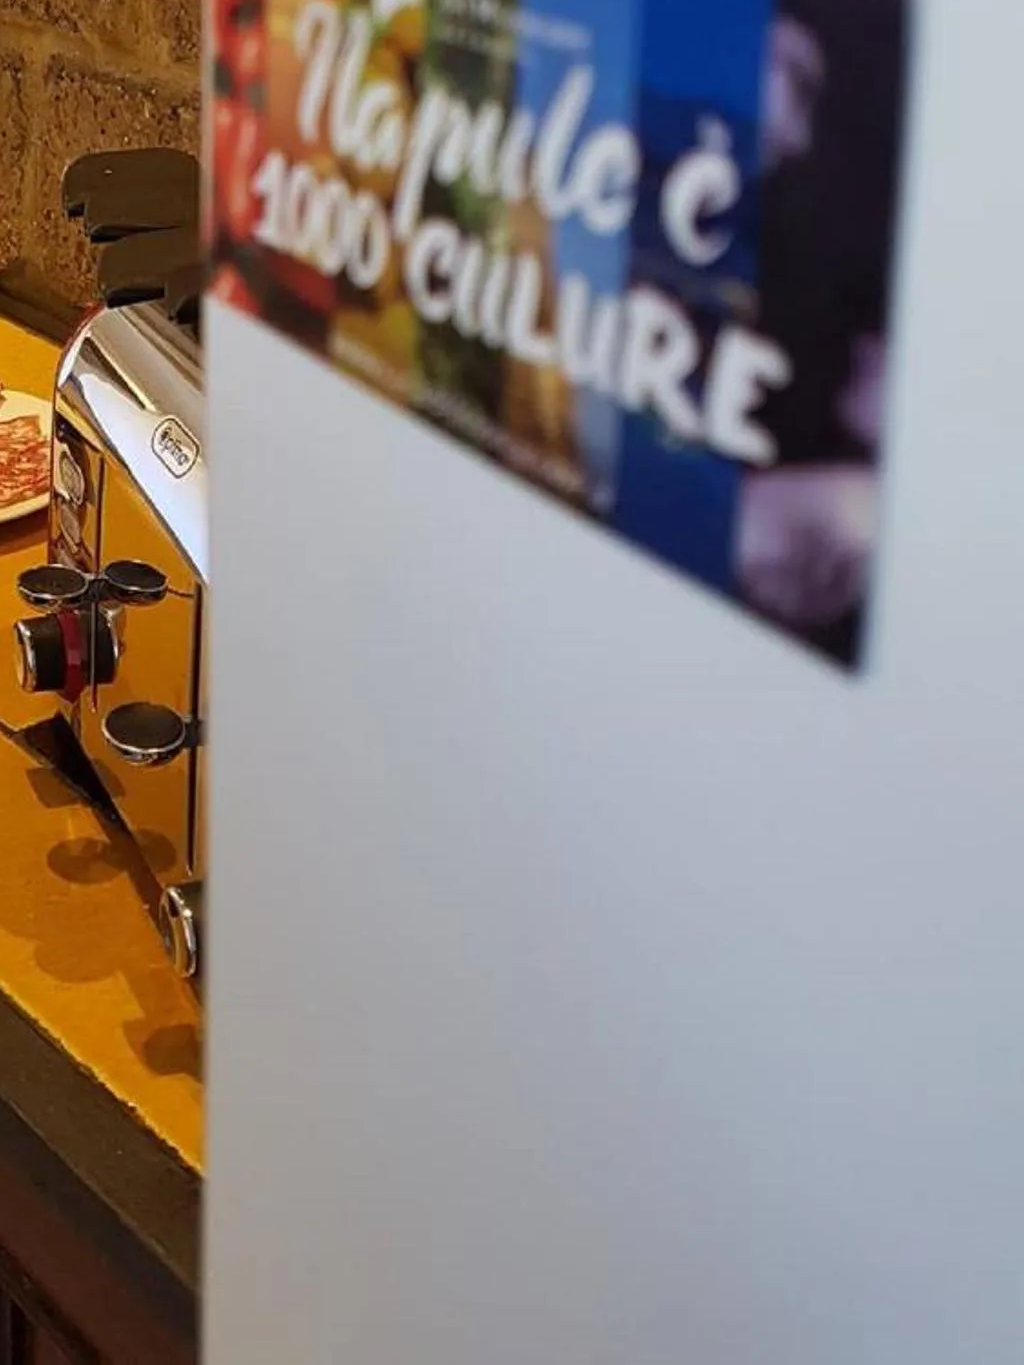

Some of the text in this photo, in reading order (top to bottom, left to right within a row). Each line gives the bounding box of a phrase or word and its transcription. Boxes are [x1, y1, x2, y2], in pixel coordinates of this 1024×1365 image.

[293, 1, 640, 235] Napule
[253, 152, 389, 290] 1000
[404, 219, 792, 466] CULURE
